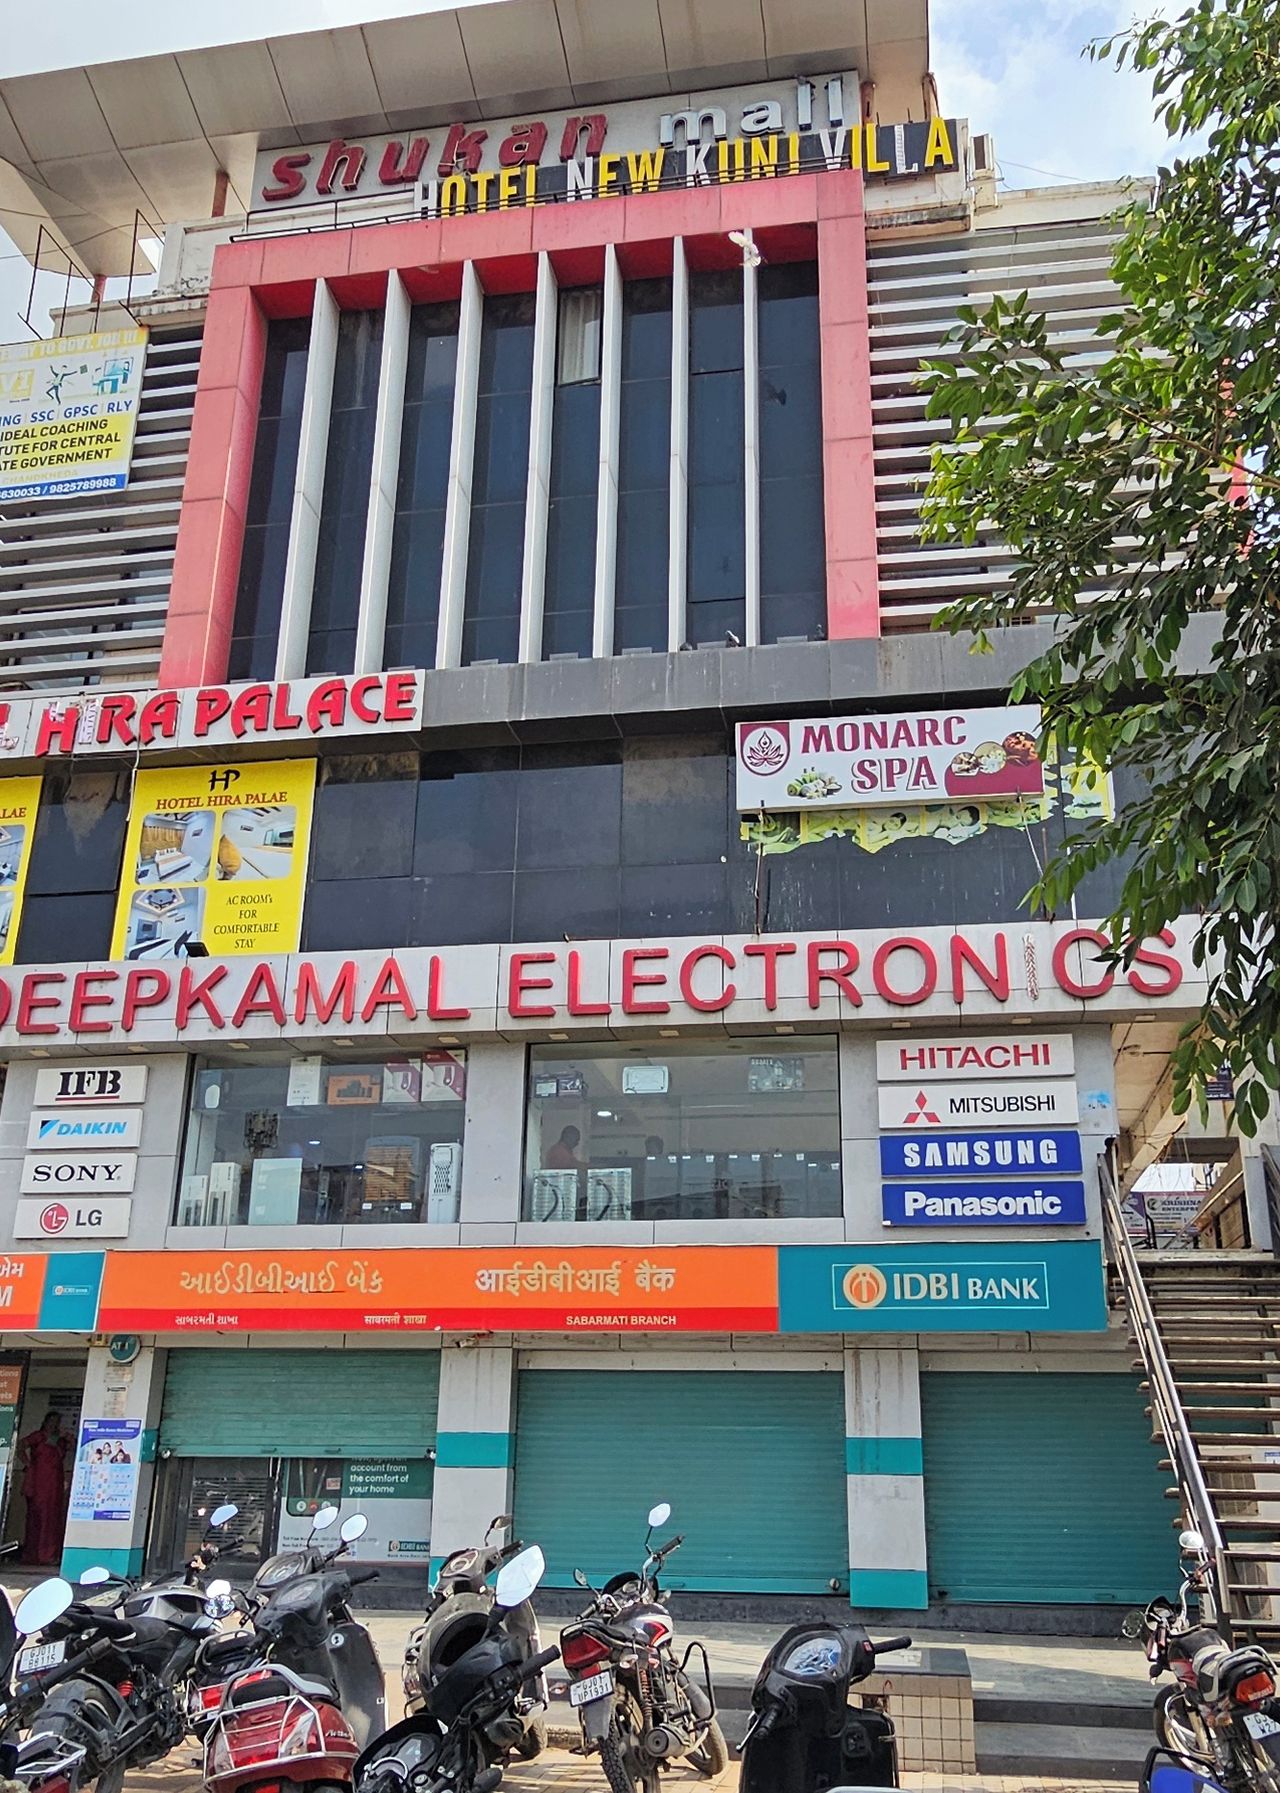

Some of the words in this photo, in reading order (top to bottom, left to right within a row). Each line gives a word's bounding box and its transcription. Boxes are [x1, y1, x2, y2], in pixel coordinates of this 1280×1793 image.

[260, 114, 608, 202] shukan
[660, 77, 843, 147] mall
[413, 163, 546, 222] HOTEL
[566, 146, 666, 202] NEW
[685, 130, 801, 188] KUNJ
[819, 116, 955, 174] VILLA
[30, 410, 55, 423] SSC
[63, 404, 99, 419] GPSC
[106, 399, 133, 413] RLY
[0, 428, 39, 442] IDEAL
[39, 419, 108, 437] COACHING
[31, 440, 58, 453] FOR
[60, 432, 121, 449] CENTRAL
[19, 448, 113, 469] GOVERNMENT
[34, 690, 179, 758] HIRA
[193, 672, 419, 739] PALACE
[800, 715, 967, 755] MONARC
[851, 755, 938, 795] SPA
[156, 797, 204, 810] HOTEL
[207, 795, 242, 807] HIRA
[244, 792, 288, 805] PALAE
[226, 895, 239, 906] AC
[240, 893, 273, 905] ROOM's
[239, 909, 258, 919] FOR
[213, 922, 280, 935] COMFORTABLE
[234, 938, 256, 949] STAY
[507, 927, 1184, 1018] ELECTRONICS
[900, 1044, 1051, 1070] HITACHI
[56, 1070, 122, 1096] IFB
[949, 1095, 1056, 1114] MITSUBISHI
[56, 1121, 128, 1136] DAIKIN
[903, 1138, 1058, 1167] SAMSUNG
[33, 1164, 123, 1182] SONY
[904, 1190, 1062, 1216] Panasonic
[75, 1209, 103, 1227] LG
[179, 1260, 340, 1295] આઈડીબીઆઈ
[347, 1260, 384, 1294] બેંક
[475, 1260, 622, 1297] आईडीबीआई
[634, 1259, 676, 1293] बैंक
[893, 1272, 960, 1300] IDBI
[967, 1277, 1040, 1300] BANK
[566, 1315, 629, 1326] SABARMATI
[630, 1315, 677, 1326] BRANCH
[350, 1463, 386, 1471] account
[386, 1463, 407, 1471] from
[350, 1474, 364, 1482] the
[365, 1474, 399, 1482] comfort
[400, 1474, 409, 1482] of
[349, 1485, 368, 1495] your
[370, 1485, 395, 1493] home
